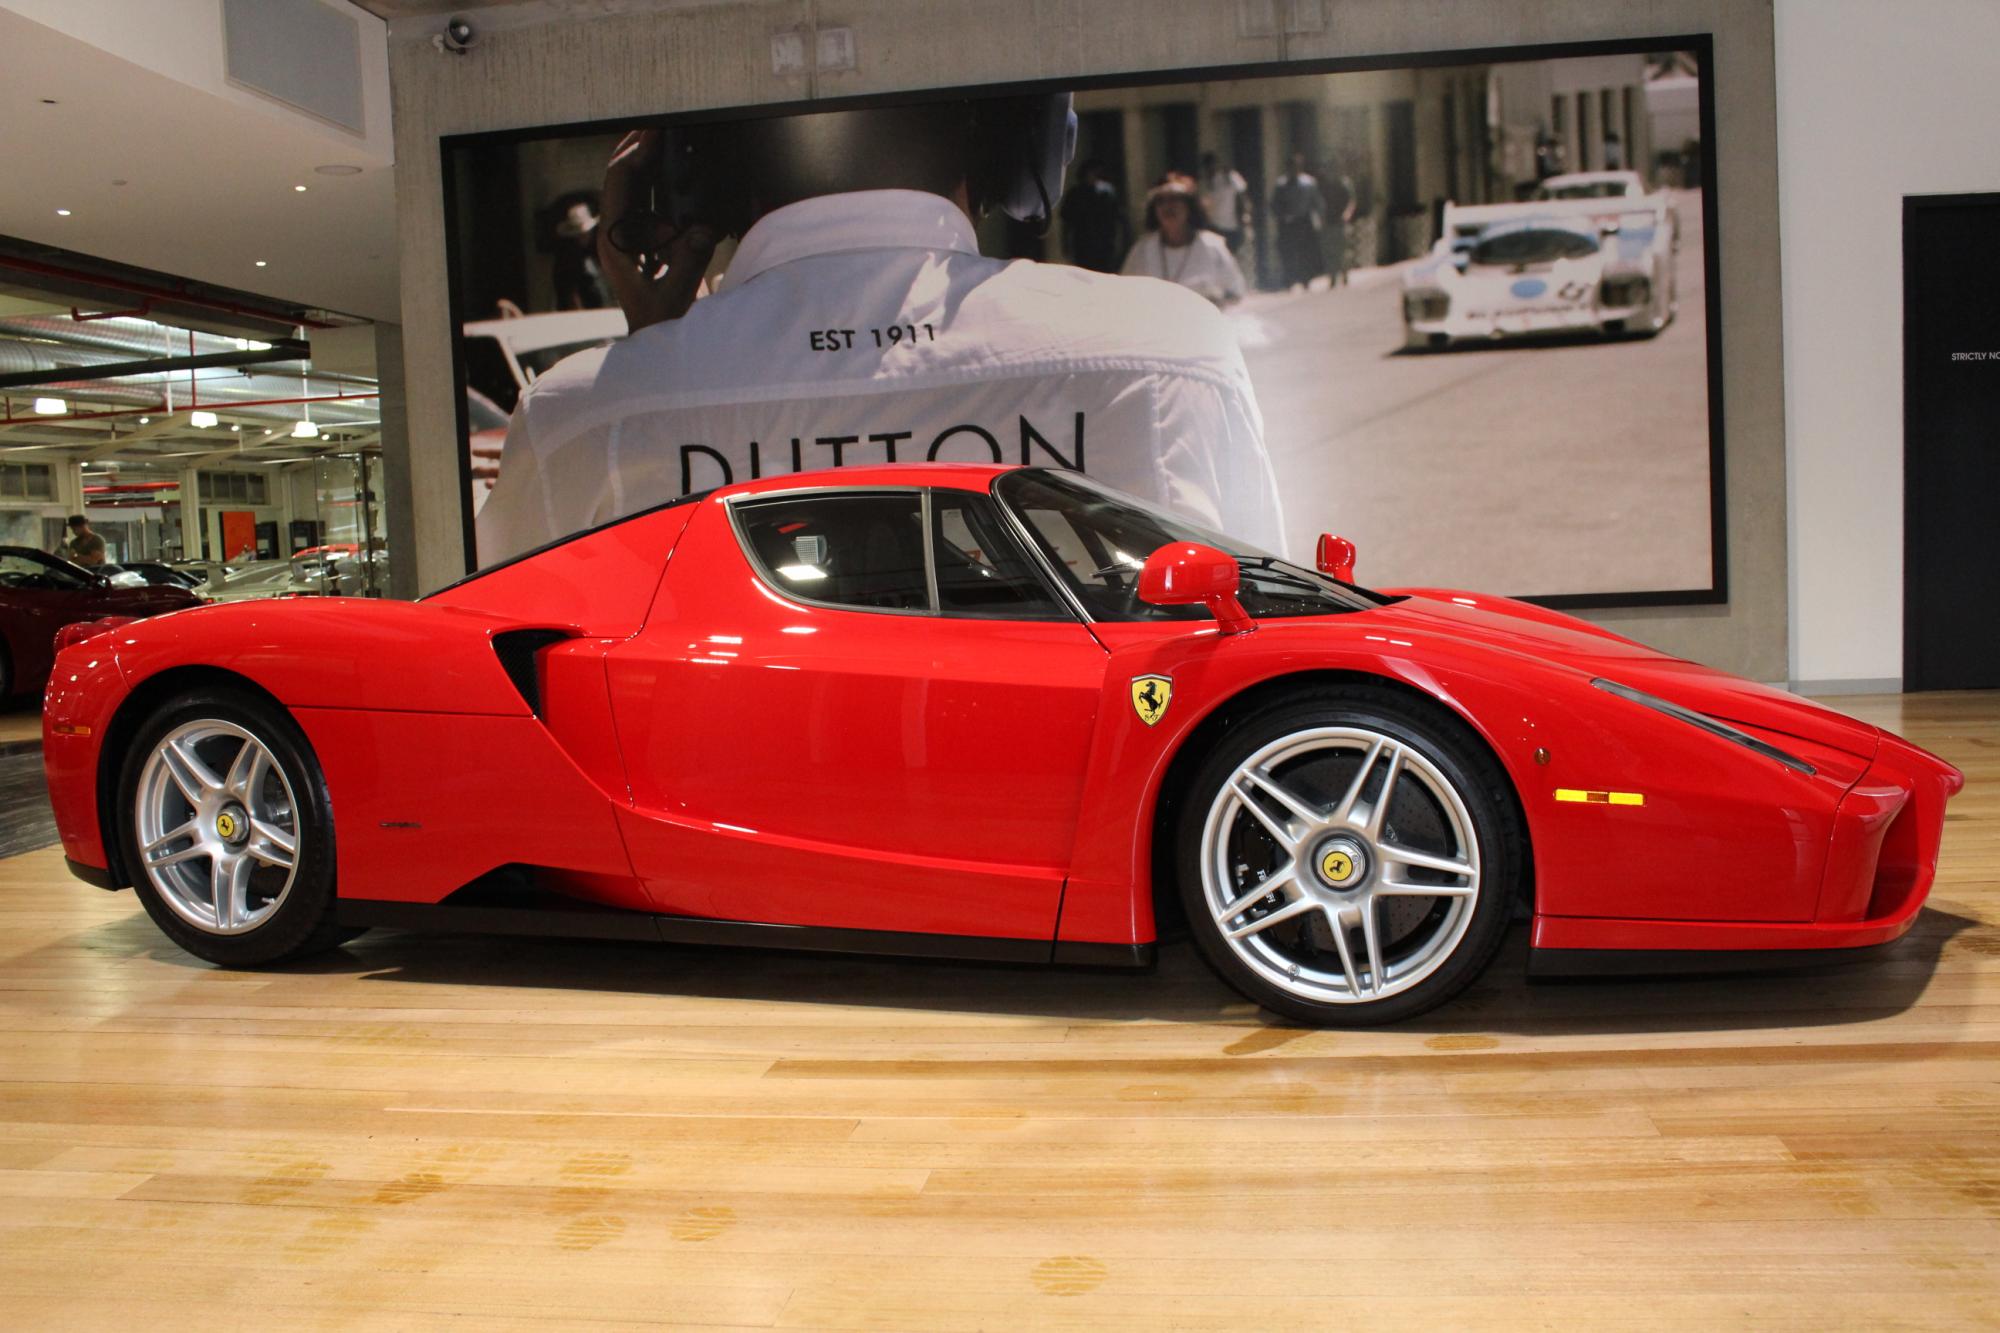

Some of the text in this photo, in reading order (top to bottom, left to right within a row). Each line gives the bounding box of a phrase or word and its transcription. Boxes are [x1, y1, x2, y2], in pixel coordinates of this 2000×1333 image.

[810, 323, 935, 351] EST 1911
[1951, 351, 1987, 361] STRICTLY
